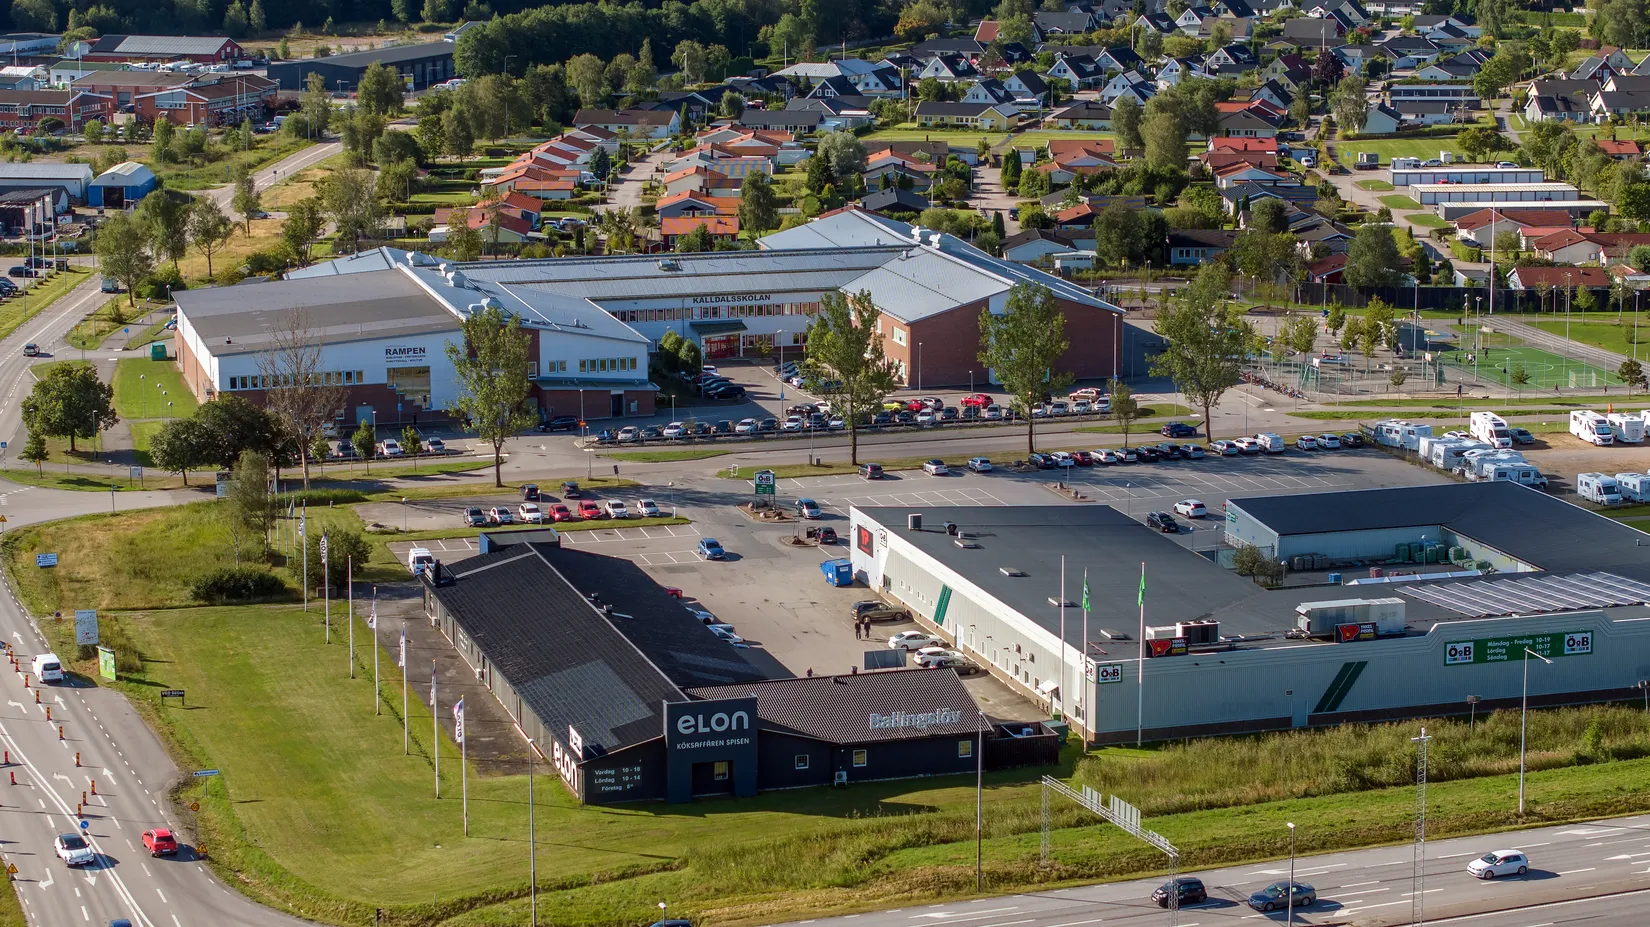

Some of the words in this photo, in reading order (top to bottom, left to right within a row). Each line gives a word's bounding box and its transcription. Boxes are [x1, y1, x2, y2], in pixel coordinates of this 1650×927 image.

[385, 347, 426, 355] RAMPEN
[1566, 635, 1590, 648] ÖoB
[1448, 645, 1472, 657] ÖoB
[1101, 668, 1119, 678] ÖoB
[870, 707, 960, 729] Ballingslöv
[676, 739, 725, 750] KÖKSAFFÄREN
[726, 737, 750, 746] SPISEN
